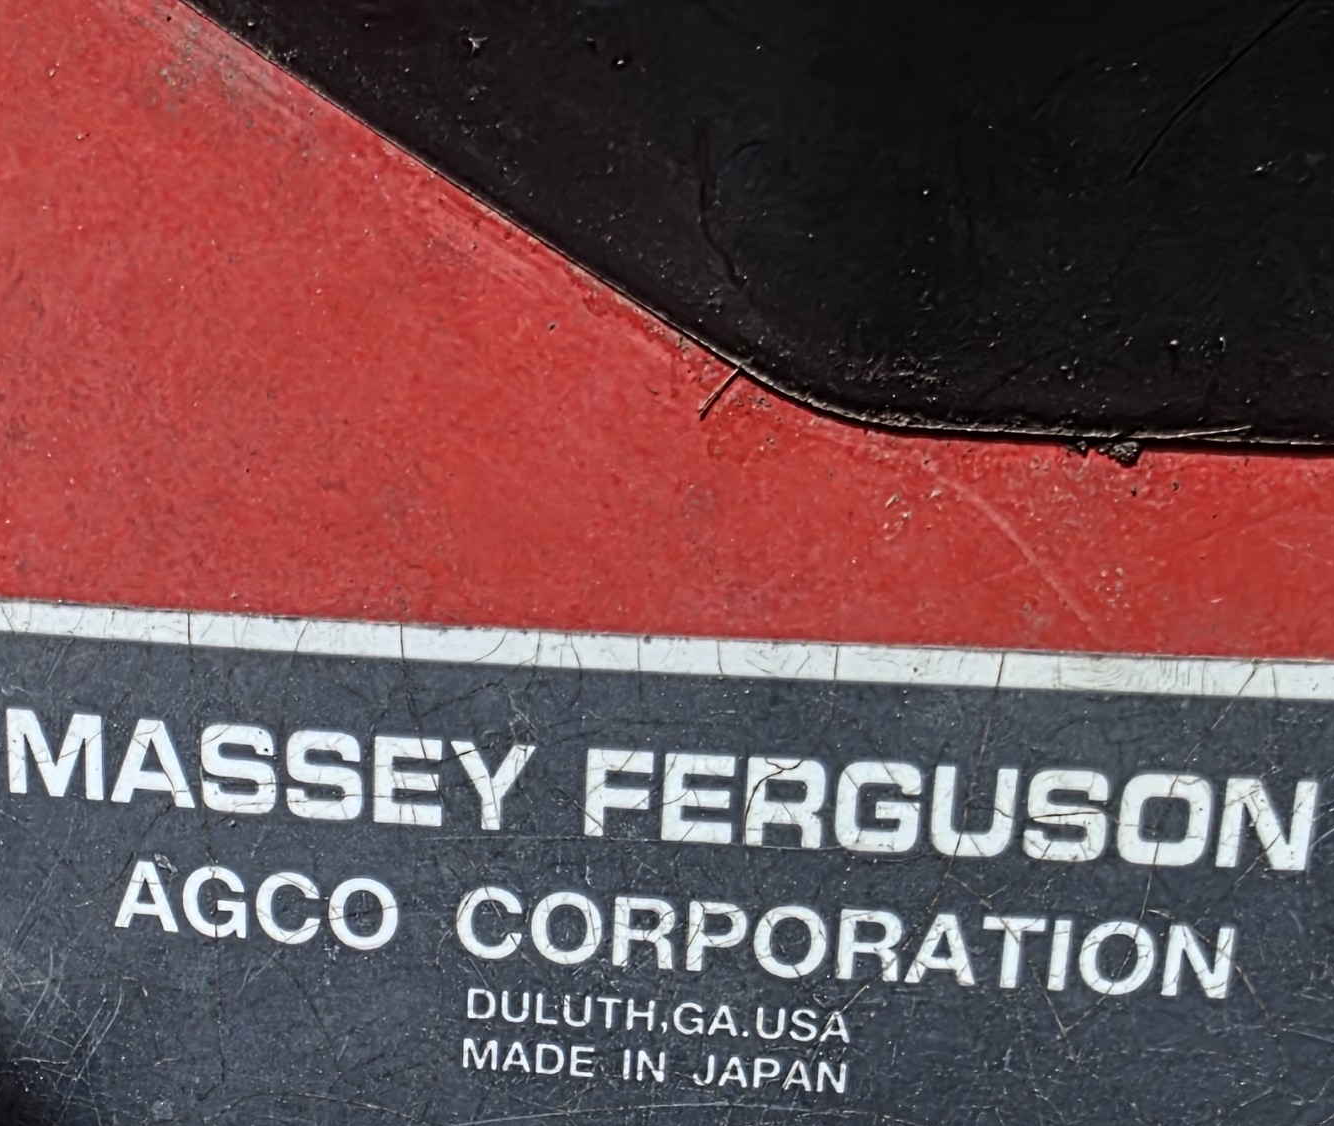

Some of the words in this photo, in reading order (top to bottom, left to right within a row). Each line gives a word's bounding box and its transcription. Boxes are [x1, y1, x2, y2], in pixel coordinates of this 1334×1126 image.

[5, 707, 535, 831] MASSEY
[583, 748, 1318, 872] FERGUSON
[114, 861, 399, 951] AGCO
[455, 886, 1235, 1000] CORPORATION
[462, 1039, 595, 1079] MADE
[622, 1050, 667, 1082] IN
[692, 1054, 848, 1094] JAPAN
